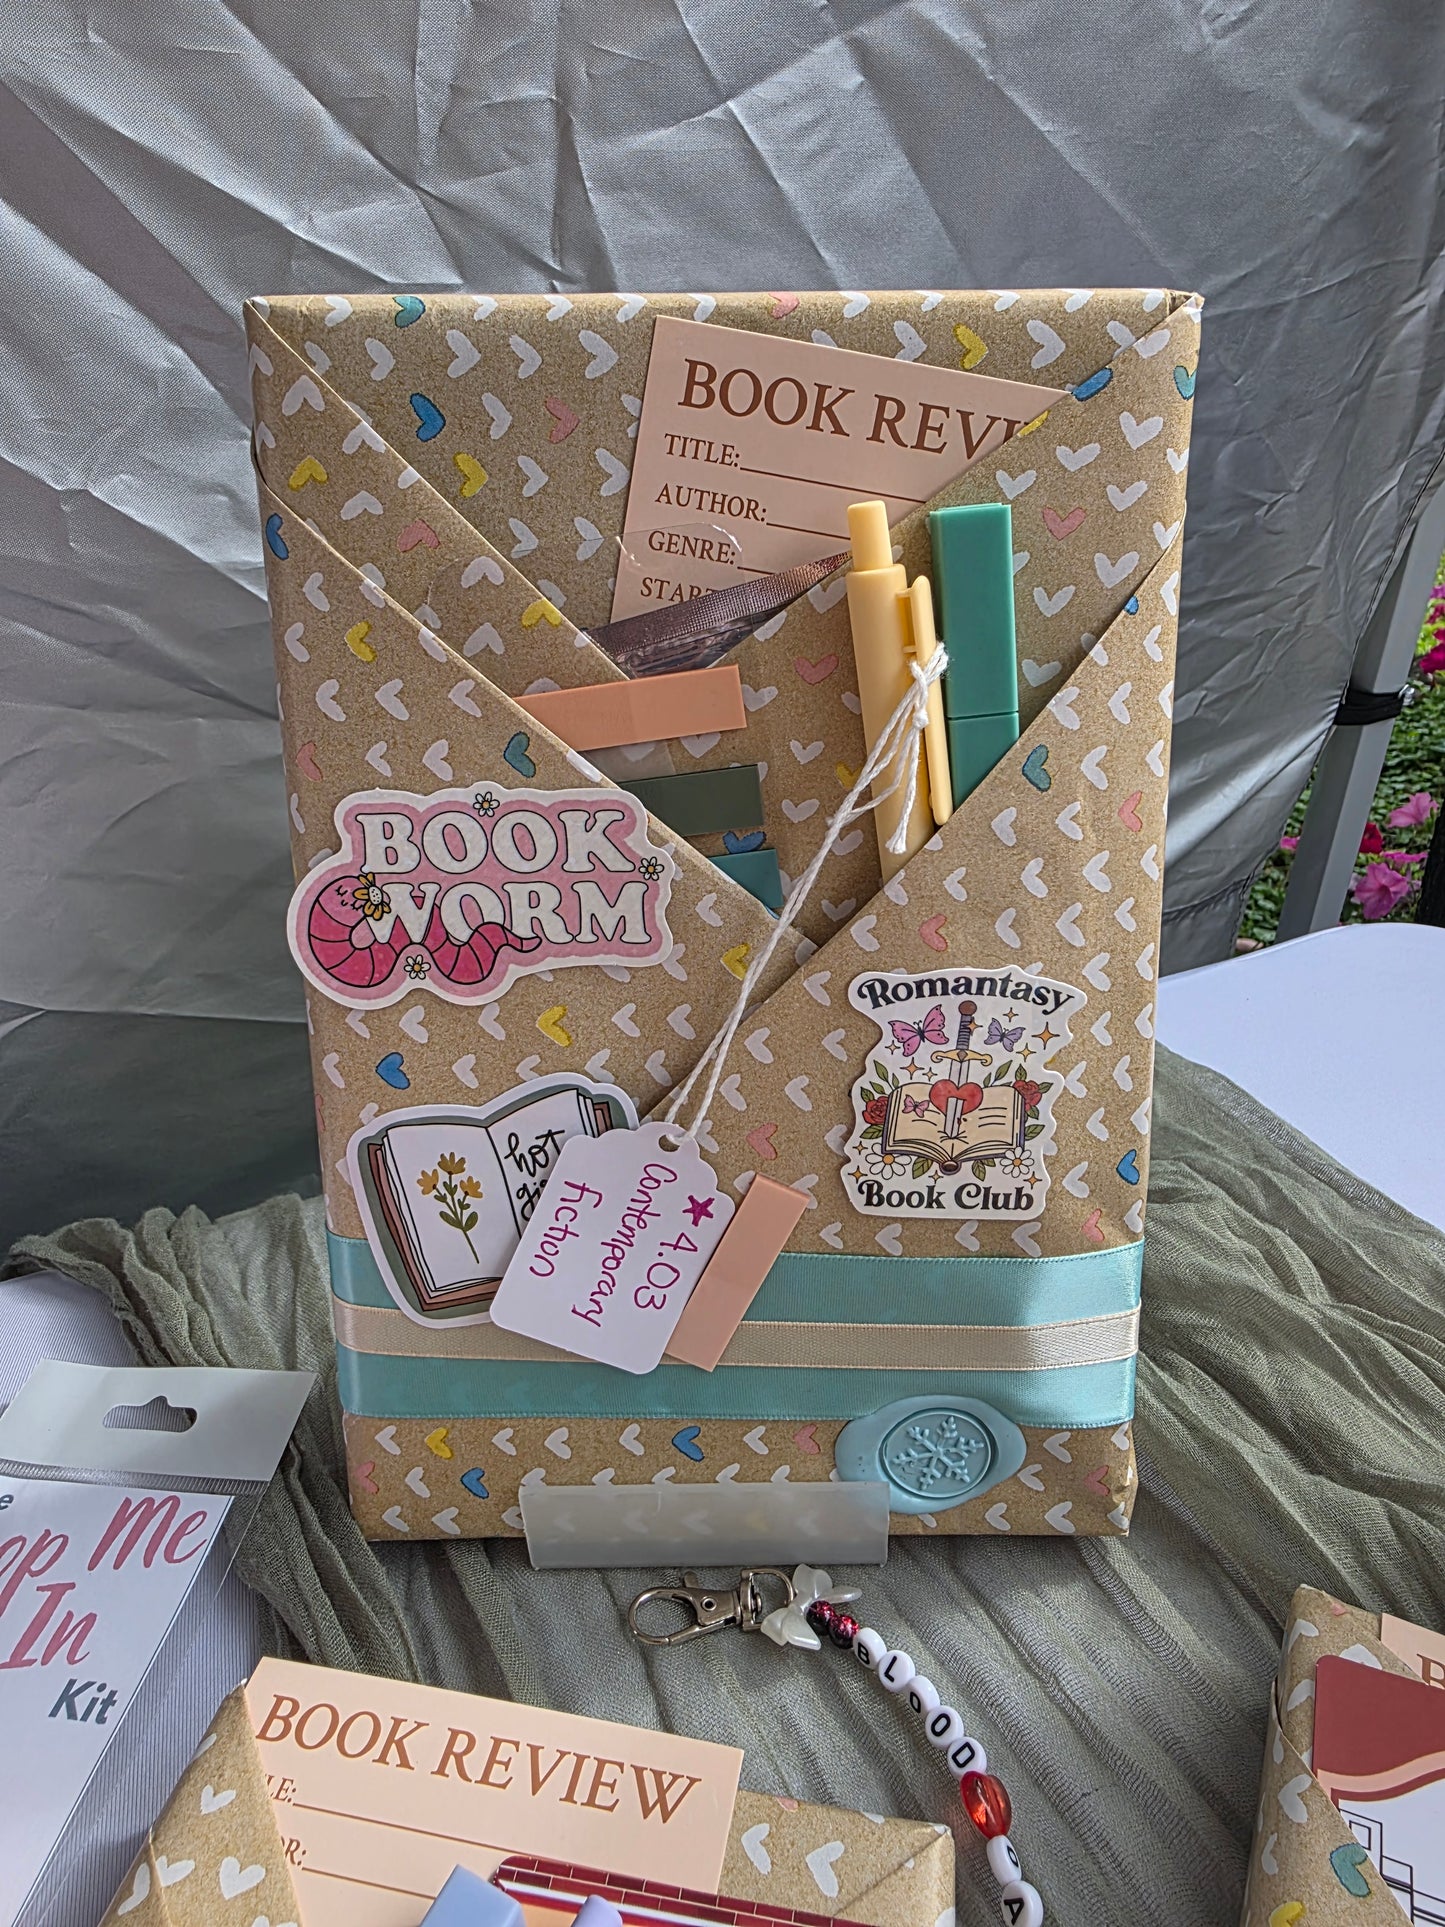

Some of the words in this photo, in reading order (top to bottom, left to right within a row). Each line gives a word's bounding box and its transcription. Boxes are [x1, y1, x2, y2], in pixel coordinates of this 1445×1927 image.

[678, 358, 855, 437] BOOK
[866, 394, 1030, 460] REVI
[664, 432, 740, 468] TITLE:
[655, 483, 767, 523] AUTHOR:
[648, 530, 736, 565] GENRE:
[355, 809, 636, 874] BOOK
[365, 881, 653, 946] WORM
[857, 972, 1075, 1016] Romantasy
[504, 1129, 565, 1177] hot
[858, 1180, 946, 1209] Book
[954, 1183, 1034, 1210] Club
[571, 1163, 678, 1327] Contemporary
[633, 1231, 699, 1310] 4.03
[87, 1495, 208, 1571] Me
[0, 1582, 98, 1669] In
[48, 1678, 118, 1725] Kit
[858, 1642, 975, 1769] BLOOD
[256, 1694, 429, 1769] BOOK
[431, 1727, 702, 1825] REVIEW
